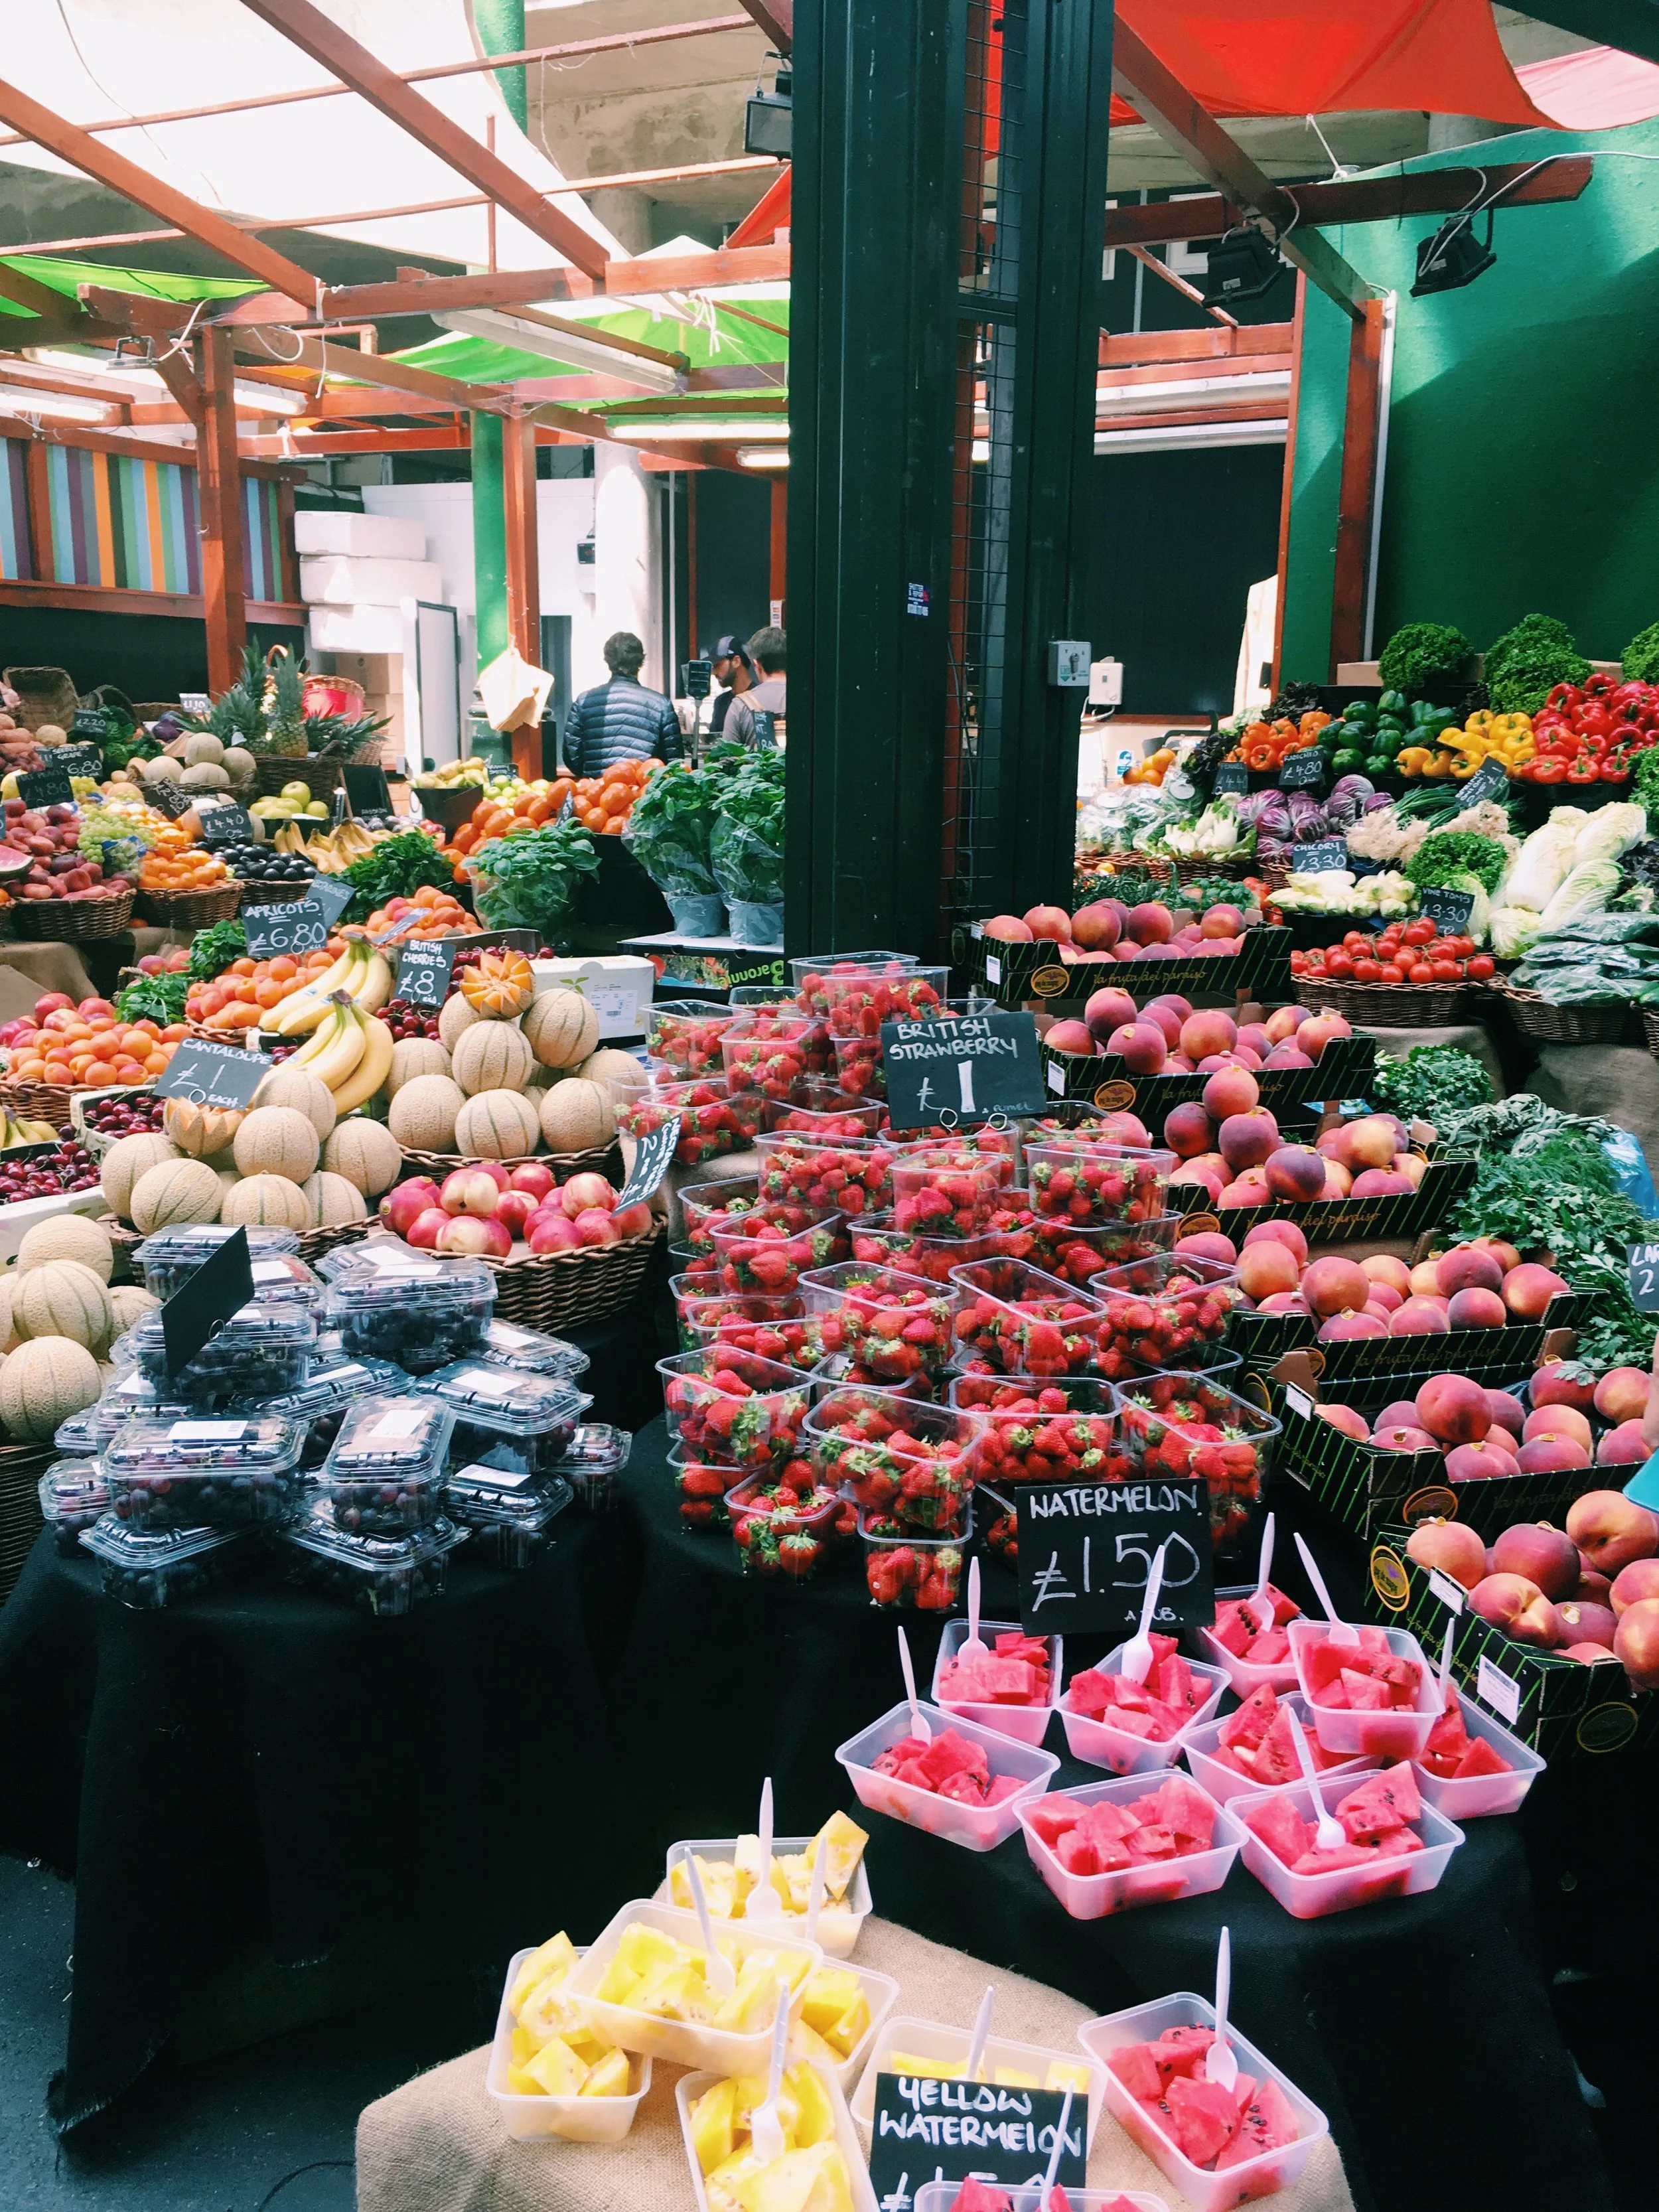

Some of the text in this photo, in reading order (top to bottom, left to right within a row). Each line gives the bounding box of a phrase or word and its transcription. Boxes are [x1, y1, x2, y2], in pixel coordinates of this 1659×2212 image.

[248, 921, 327, 956] £6.80
[398, 970, 435, 995] £8
[897, 1017, 991, 1040] BRITISH
[181, 1038, 273, 1065] CANTALOUPE
[889, 1037, 1019, 1060] STRAWBERRY
[169, 1063, 226, 1090] £1
[916, 1060, 976, 1113] £1
[1638, 1269, 1655, 1295] 2
[1031, 1531, 1200, 1612] £1.50
[898, 2076, 1033, 2116] YELLOW
